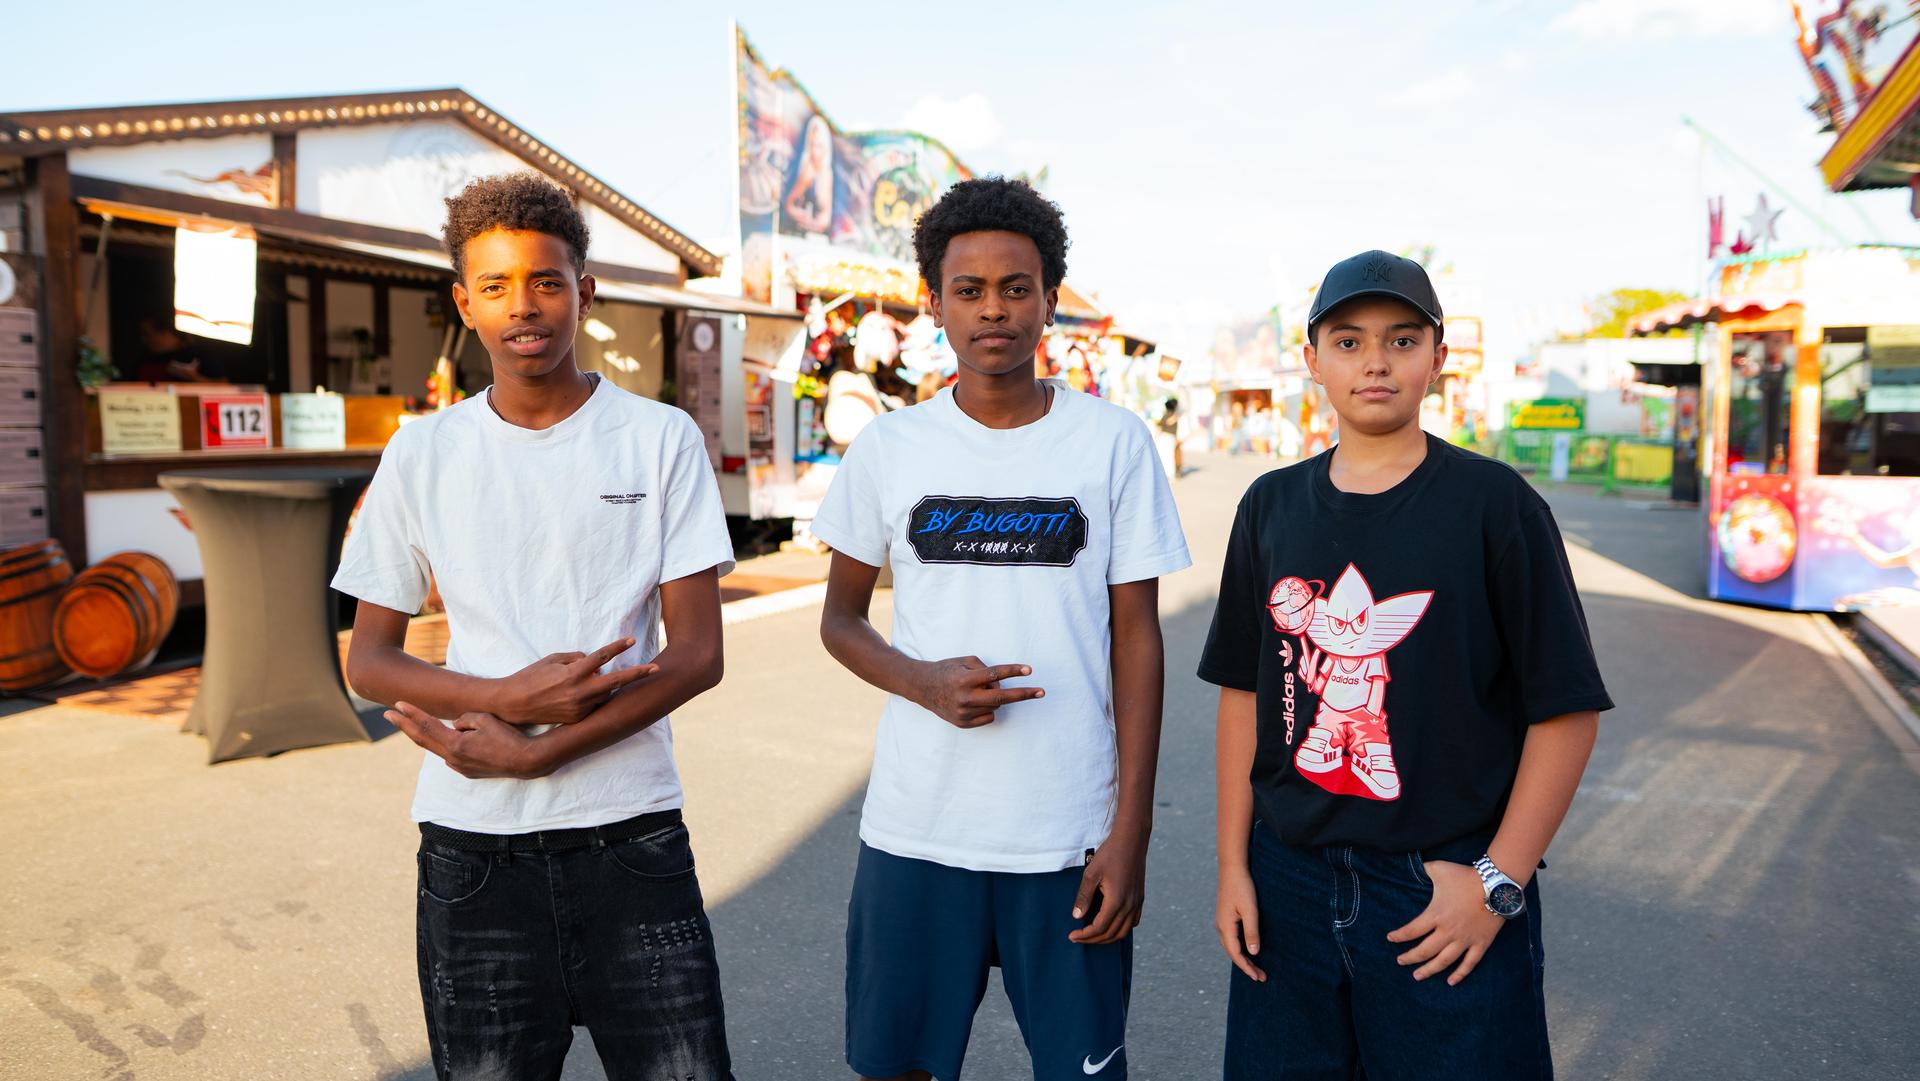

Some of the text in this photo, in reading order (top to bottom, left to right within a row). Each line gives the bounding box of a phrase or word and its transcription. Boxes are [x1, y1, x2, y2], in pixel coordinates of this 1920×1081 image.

[225, 409, 262, 432] 112
[913, 506, 964, 534] BY
[1331, 674, 1360, 685] adidas
[1282, 672, 1295, 745] adidas
